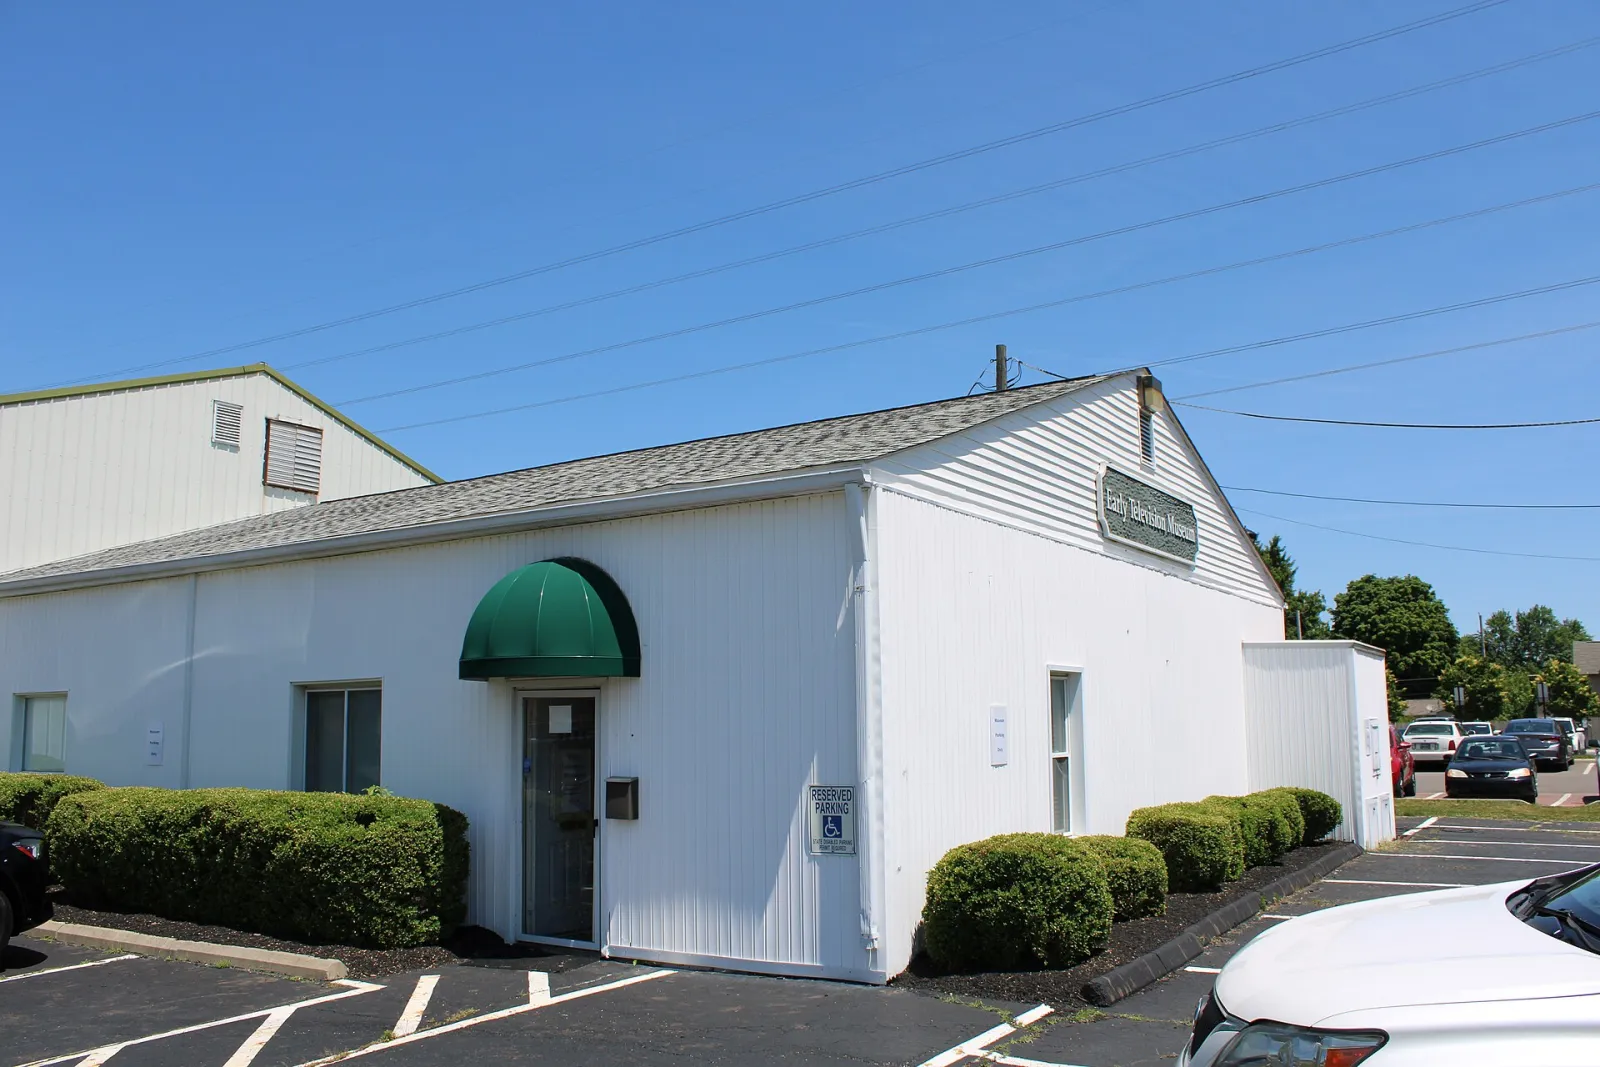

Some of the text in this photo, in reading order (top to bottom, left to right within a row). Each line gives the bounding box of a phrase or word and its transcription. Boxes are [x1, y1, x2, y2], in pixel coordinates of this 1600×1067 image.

[1106, 488, 1196, 543] Early Television Museum
[812, 789, 852, 801] RESERVED
[815, 802, 849, 814] PARKING
